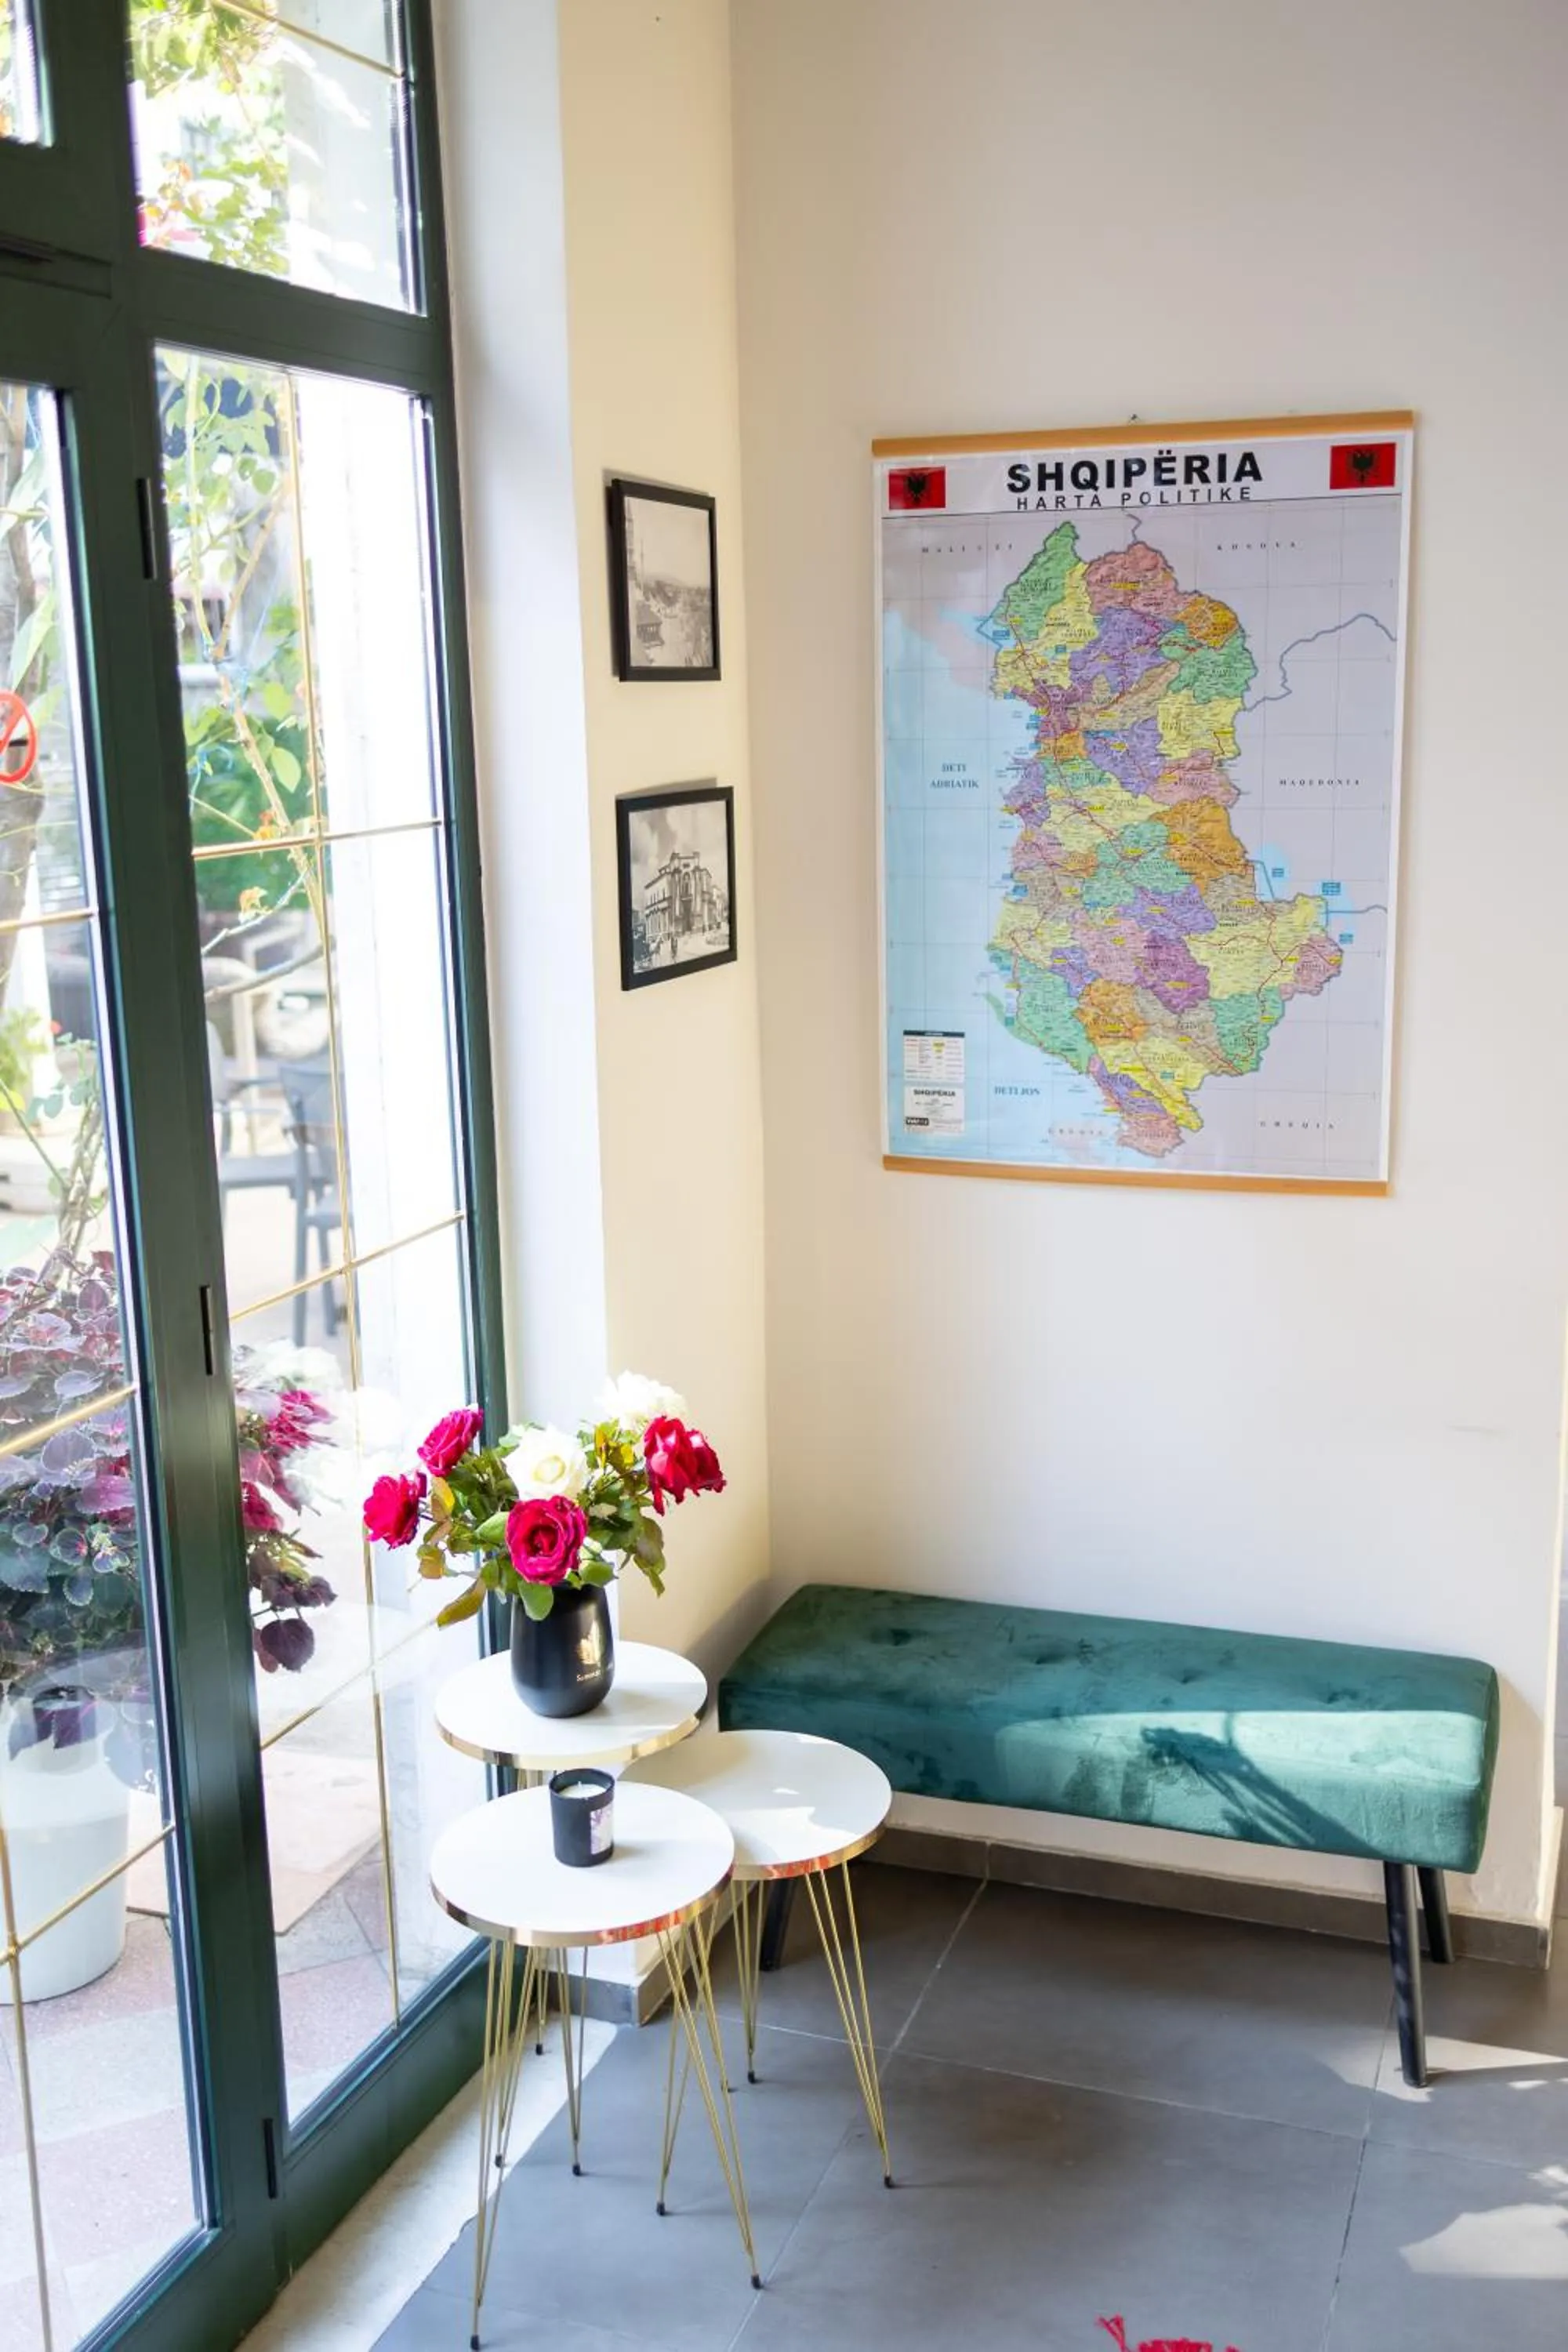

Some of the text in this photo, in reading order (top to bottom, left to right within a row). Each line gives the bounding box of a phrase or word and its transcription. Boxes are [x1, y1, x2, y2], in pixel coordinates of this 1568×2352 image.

[1007, 449, 1263, 493] SHQIPËRIA
[1017, 486, 1252, 510] HARTA POLITIKE
